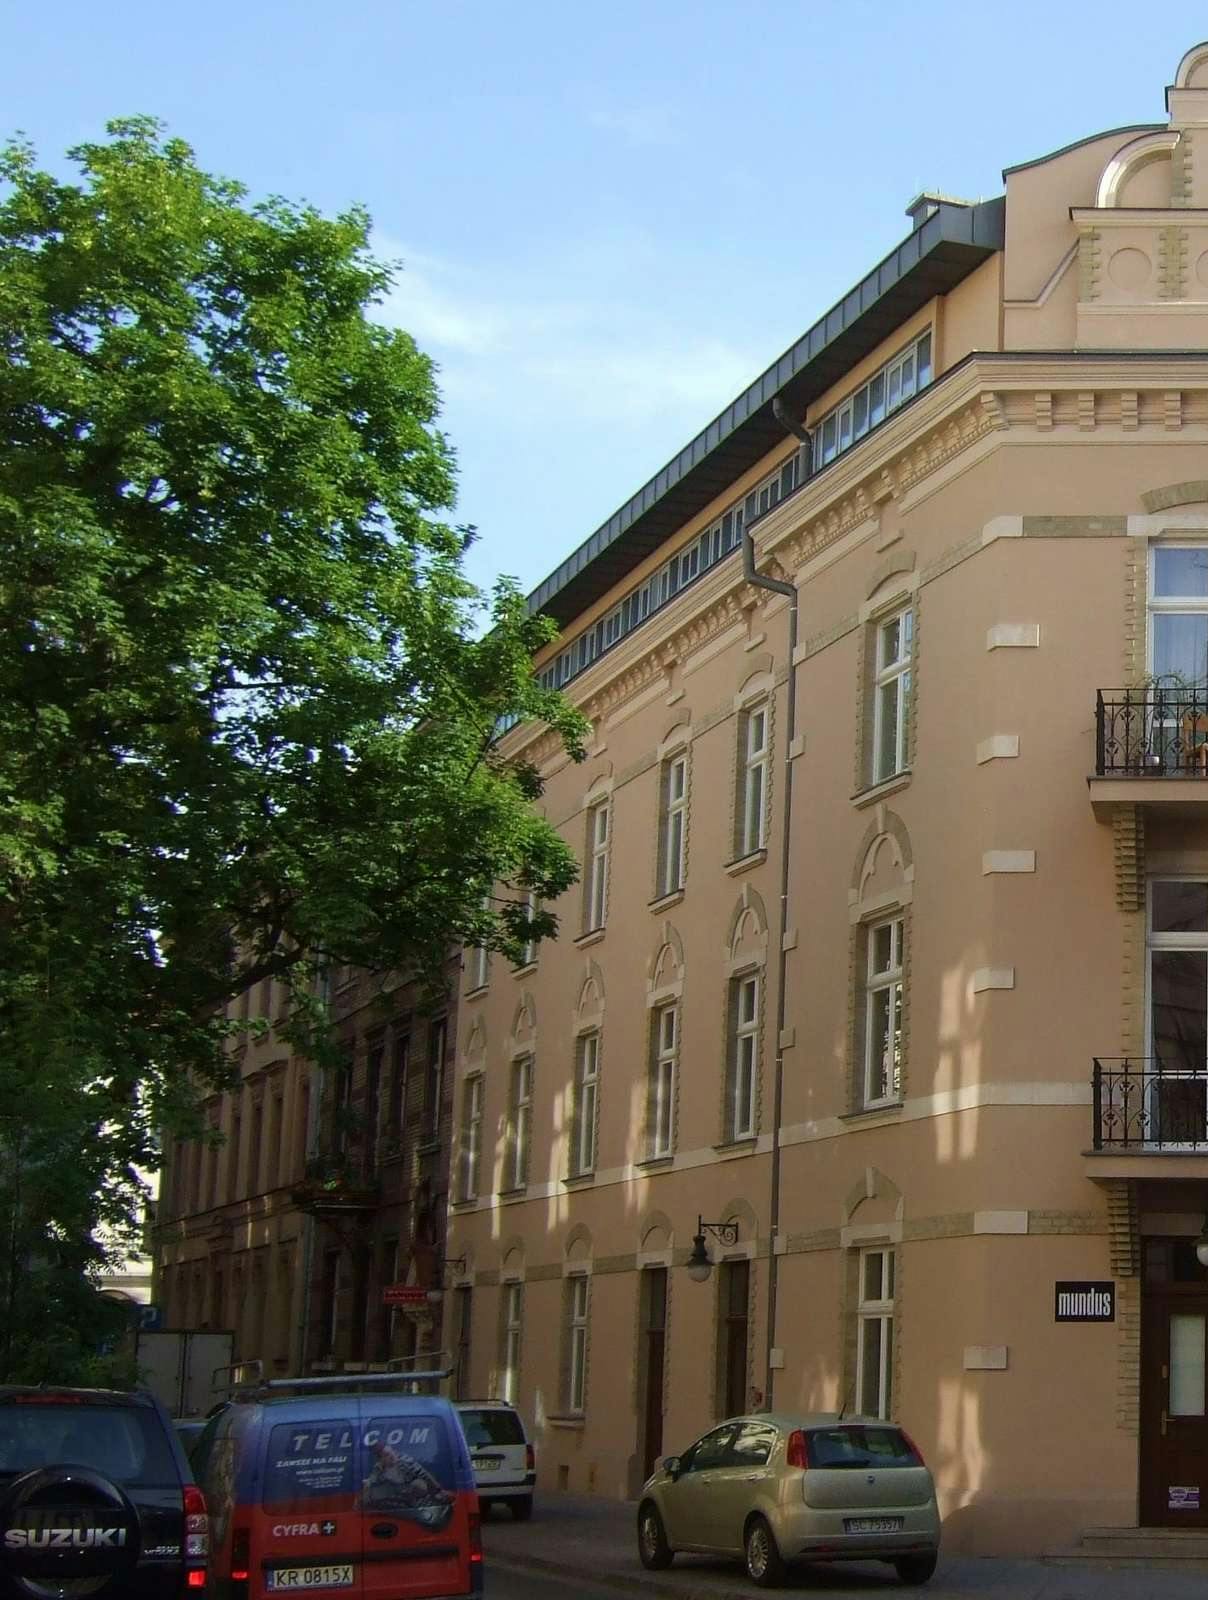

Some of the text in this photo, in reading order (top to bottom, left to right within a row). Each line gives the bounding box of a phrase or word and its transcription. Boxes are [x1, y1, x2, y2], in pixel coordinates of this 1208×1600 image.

[1058, 1287, 1111, 1316] mundus
[292, 1427, 430, 1452] TELCOM
[4, 1528, 127, 1548] SUZUKI
[276, 1567, 350, 1585] KR 0815X
